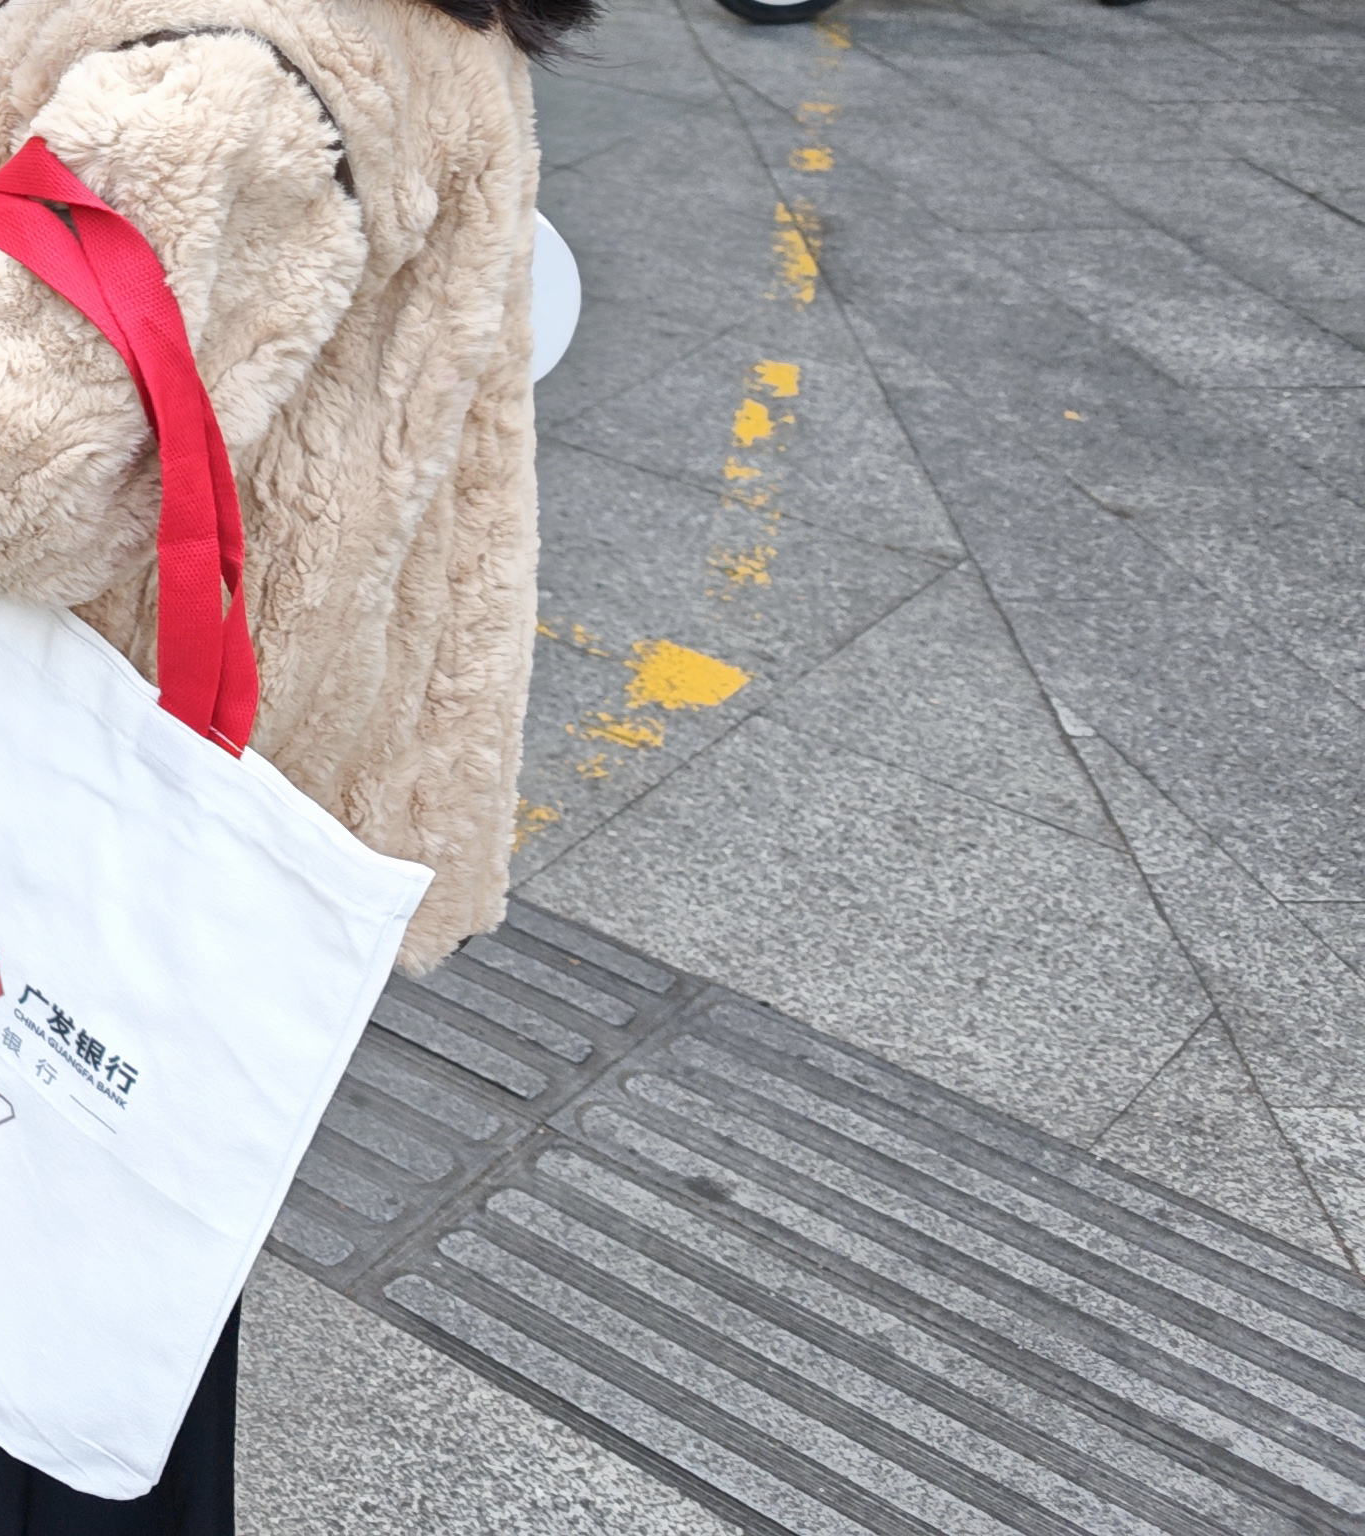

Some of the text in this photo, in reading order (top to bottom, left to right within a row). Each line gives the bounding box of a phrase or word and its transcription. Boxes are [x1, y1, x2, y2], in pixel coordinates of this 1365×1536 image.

[13, 1007, 128, 1111] CHINA GUANGFA BANK
[17, 983, 140, 1096] 广发银行
